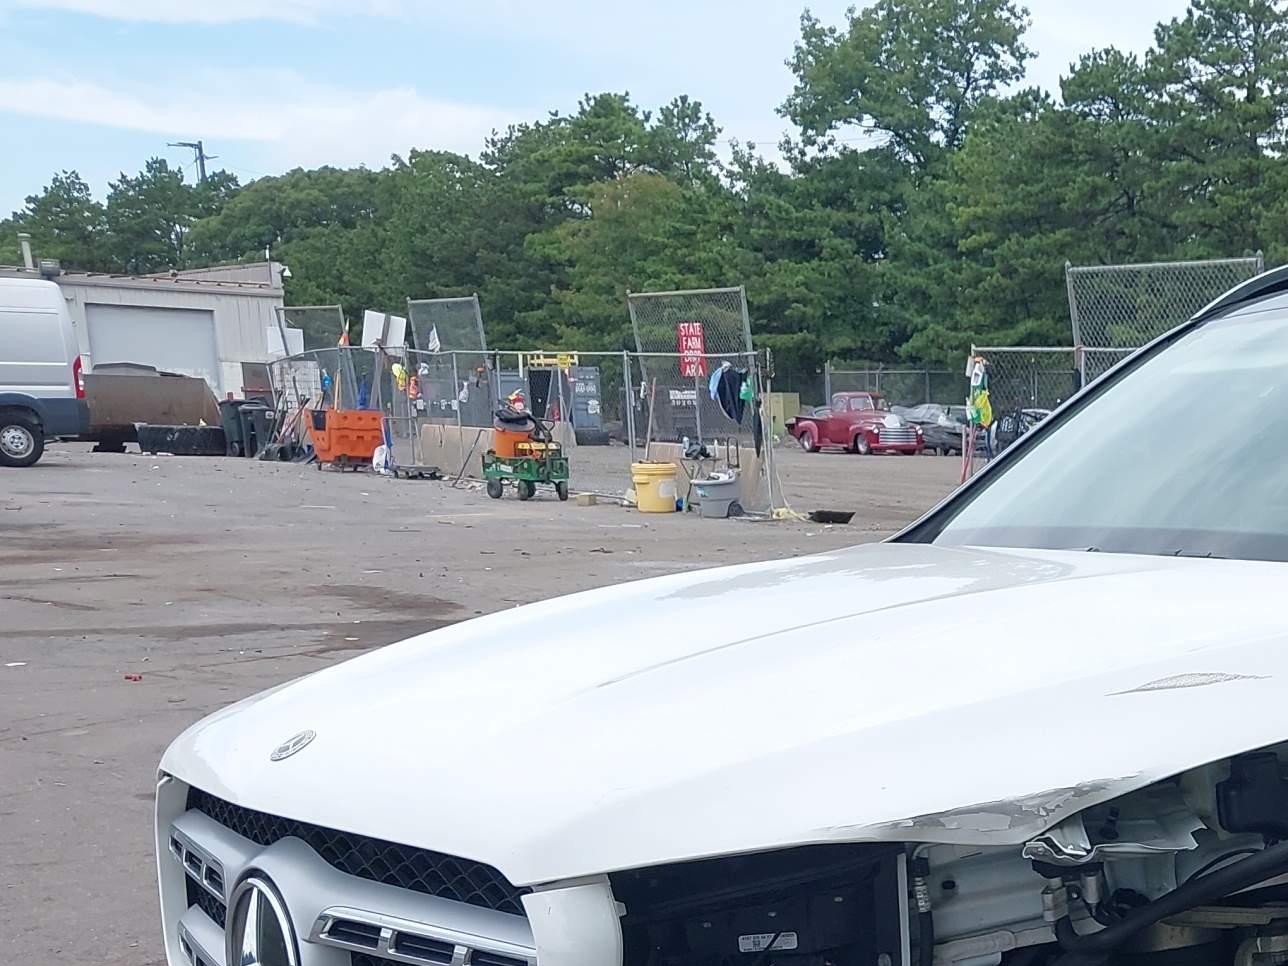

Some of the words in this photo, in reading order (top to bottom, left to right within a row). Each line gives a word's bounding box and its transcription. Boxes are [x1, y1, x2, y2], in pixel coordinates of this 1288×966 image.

[680, 322, 702, 336] STATE
[682, 336, 702, 350] FARM
[685, 364, 704, 377] ARA
